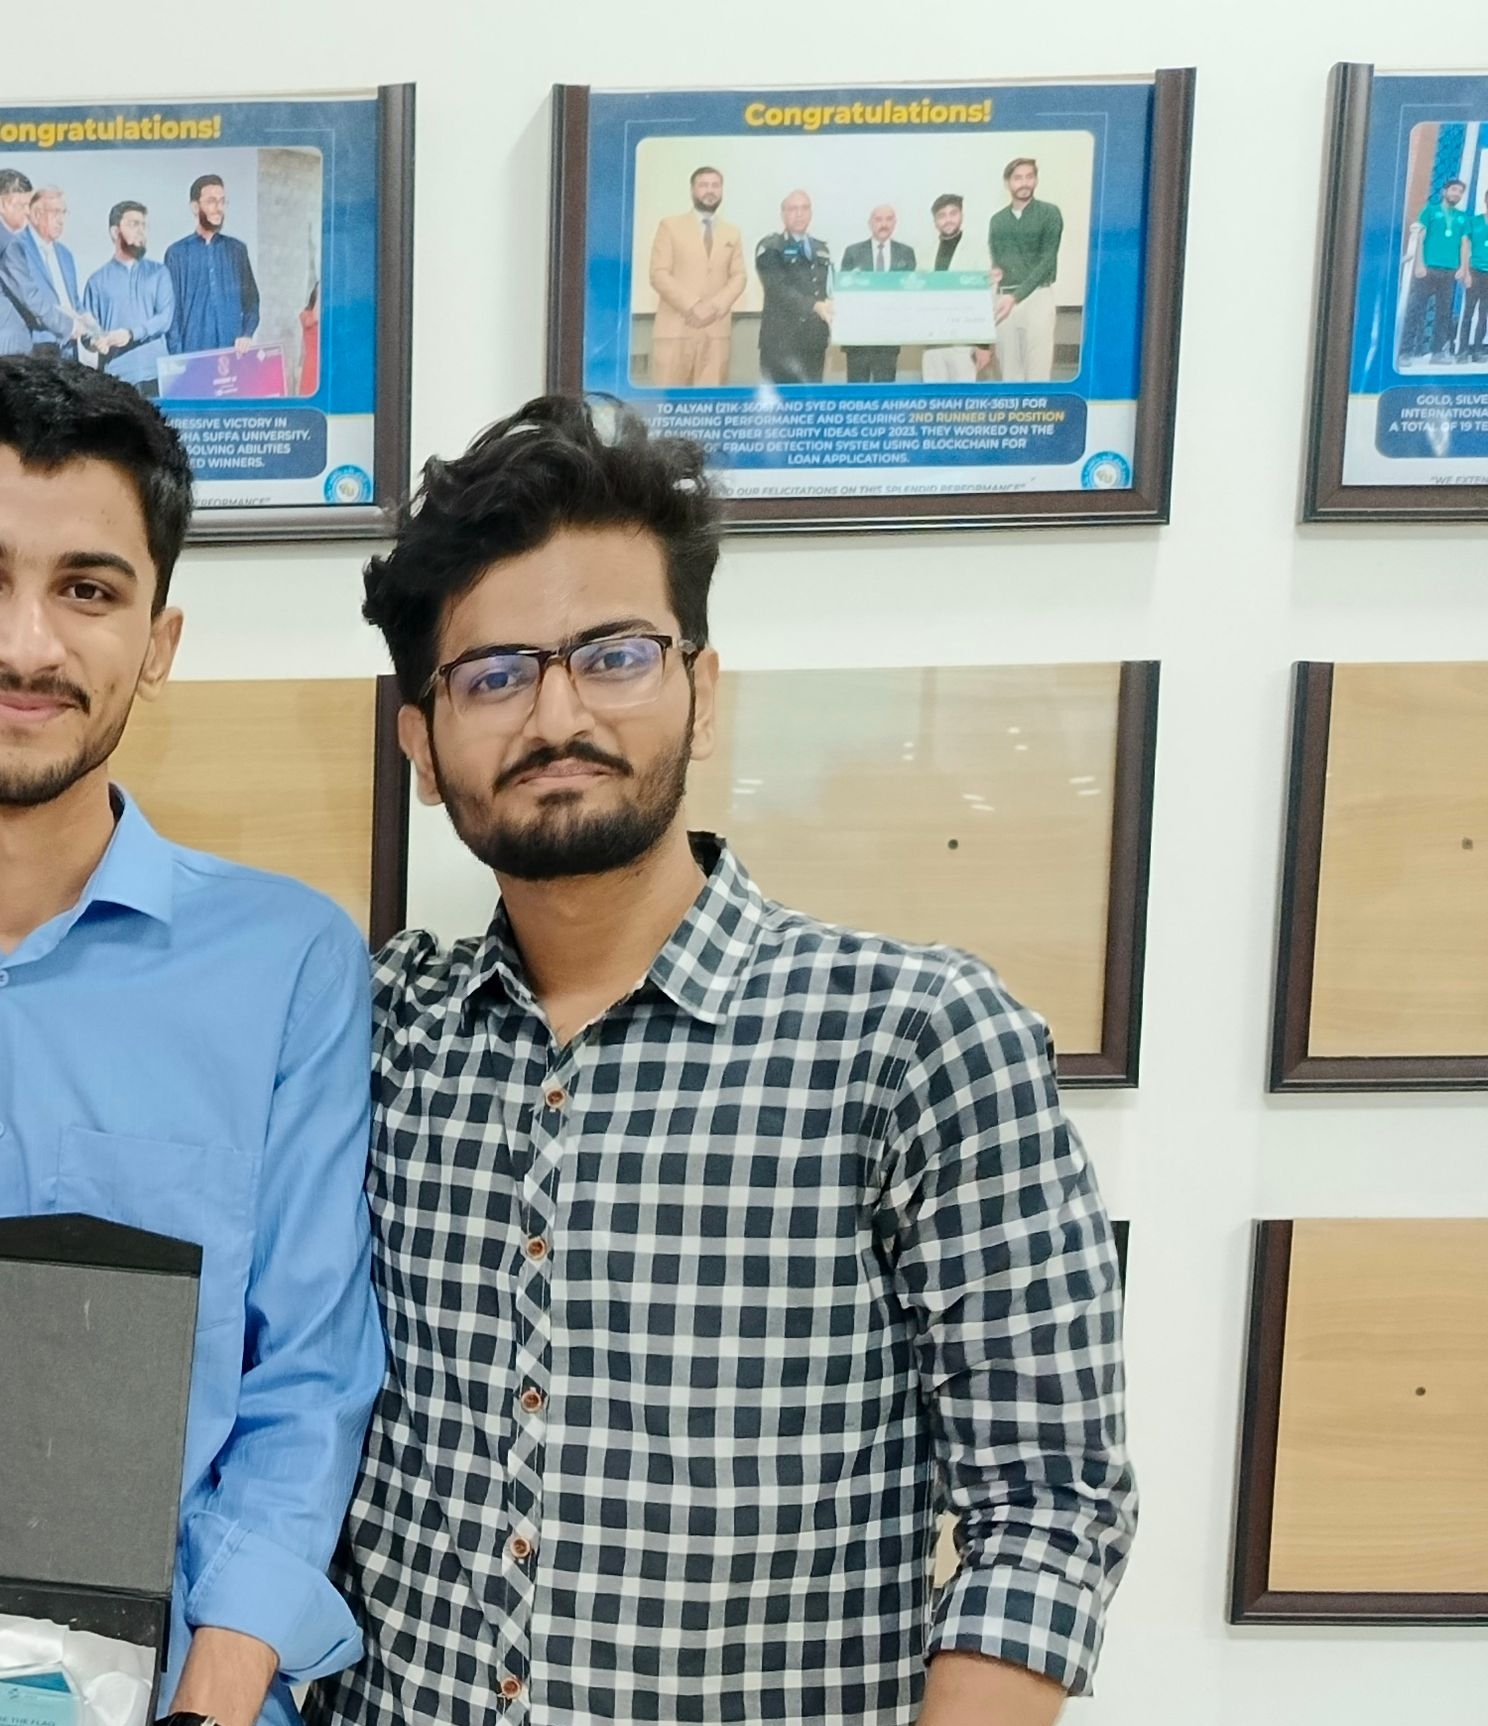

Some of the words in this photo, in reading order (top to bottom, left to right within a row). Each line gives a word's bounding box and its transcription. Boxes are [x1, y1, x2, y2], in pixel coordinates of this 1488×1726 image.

[744, 98, 992, 130] Congratulations!
[657, 403, 673, 414] TO
[675, 403, 713, 414] ALYAN
[777, 401, 803, 412] AND
[805, 400, 837, 412] SYED
[838, 399, 879, 411] ROBAS
[882, 399, 927, 410] AHMAD
[929, 399, 963, 410] SHAH
[1022, 398, 1048, 409] FOR
[1416, 394, 1453, 406] GOLD,
[223, 416, 271, 429] VICTORY
[274, 416, 288, 428] IN
[725, 414, 815, 426] PERFORMANCE
[817, 414, 844, 425] AND
[846, 413, 906, 425] SECURING
[908, 412, 934, 423] 2ND
[936, 412, 987, 423] RUNNER
[989, 411, 1006, 422] UP
[1008, 411, 1065, 422] POSITION
[723, 428, 762, 439] CYBER
[764, 427, 821, 439] SECURITY
[824, 427, 858, 438] IDEAS
[861, 426, 886, 437] CUP
[921, 425, 952, 436] THEY
[954, 425, 1008, 436] WORKED
[1009, 424, 1029, 435] ON
[1031, 424, 1055, 435] THE
[1389, 421, 1399, 432] A
[1401, 421, 1436, 433] TOTAL
[1440, 421, 1458, 433] OF
[1460, 421, 1472, 432] 19
[203, 430, 240, 442] SUFFA
[242, 429, 311, 442] UNIVERSITY.
[186, 444, 236, 456] SOLVING
[238, 443, 292, 455] ABILITIES
[723, 441, 764, 452] FRAUD
[767, 441, 833, 452] DETECTION
[835, 439, 882, 451] SYSTEM
[883, 439, 920, 450] USING
[922, 438, 1000, 450] BLOCKCHAIN
[1002, 438, 1027, 449] FOR
[208, 456, 265, 468] WINNERS.
[788, 453, 821, 465] LOAN
[823, 452, 910, 464] APPLICATIONS.
[736, 487, 760, 496] OUR
[11, 1716, 28, 1725] THE
